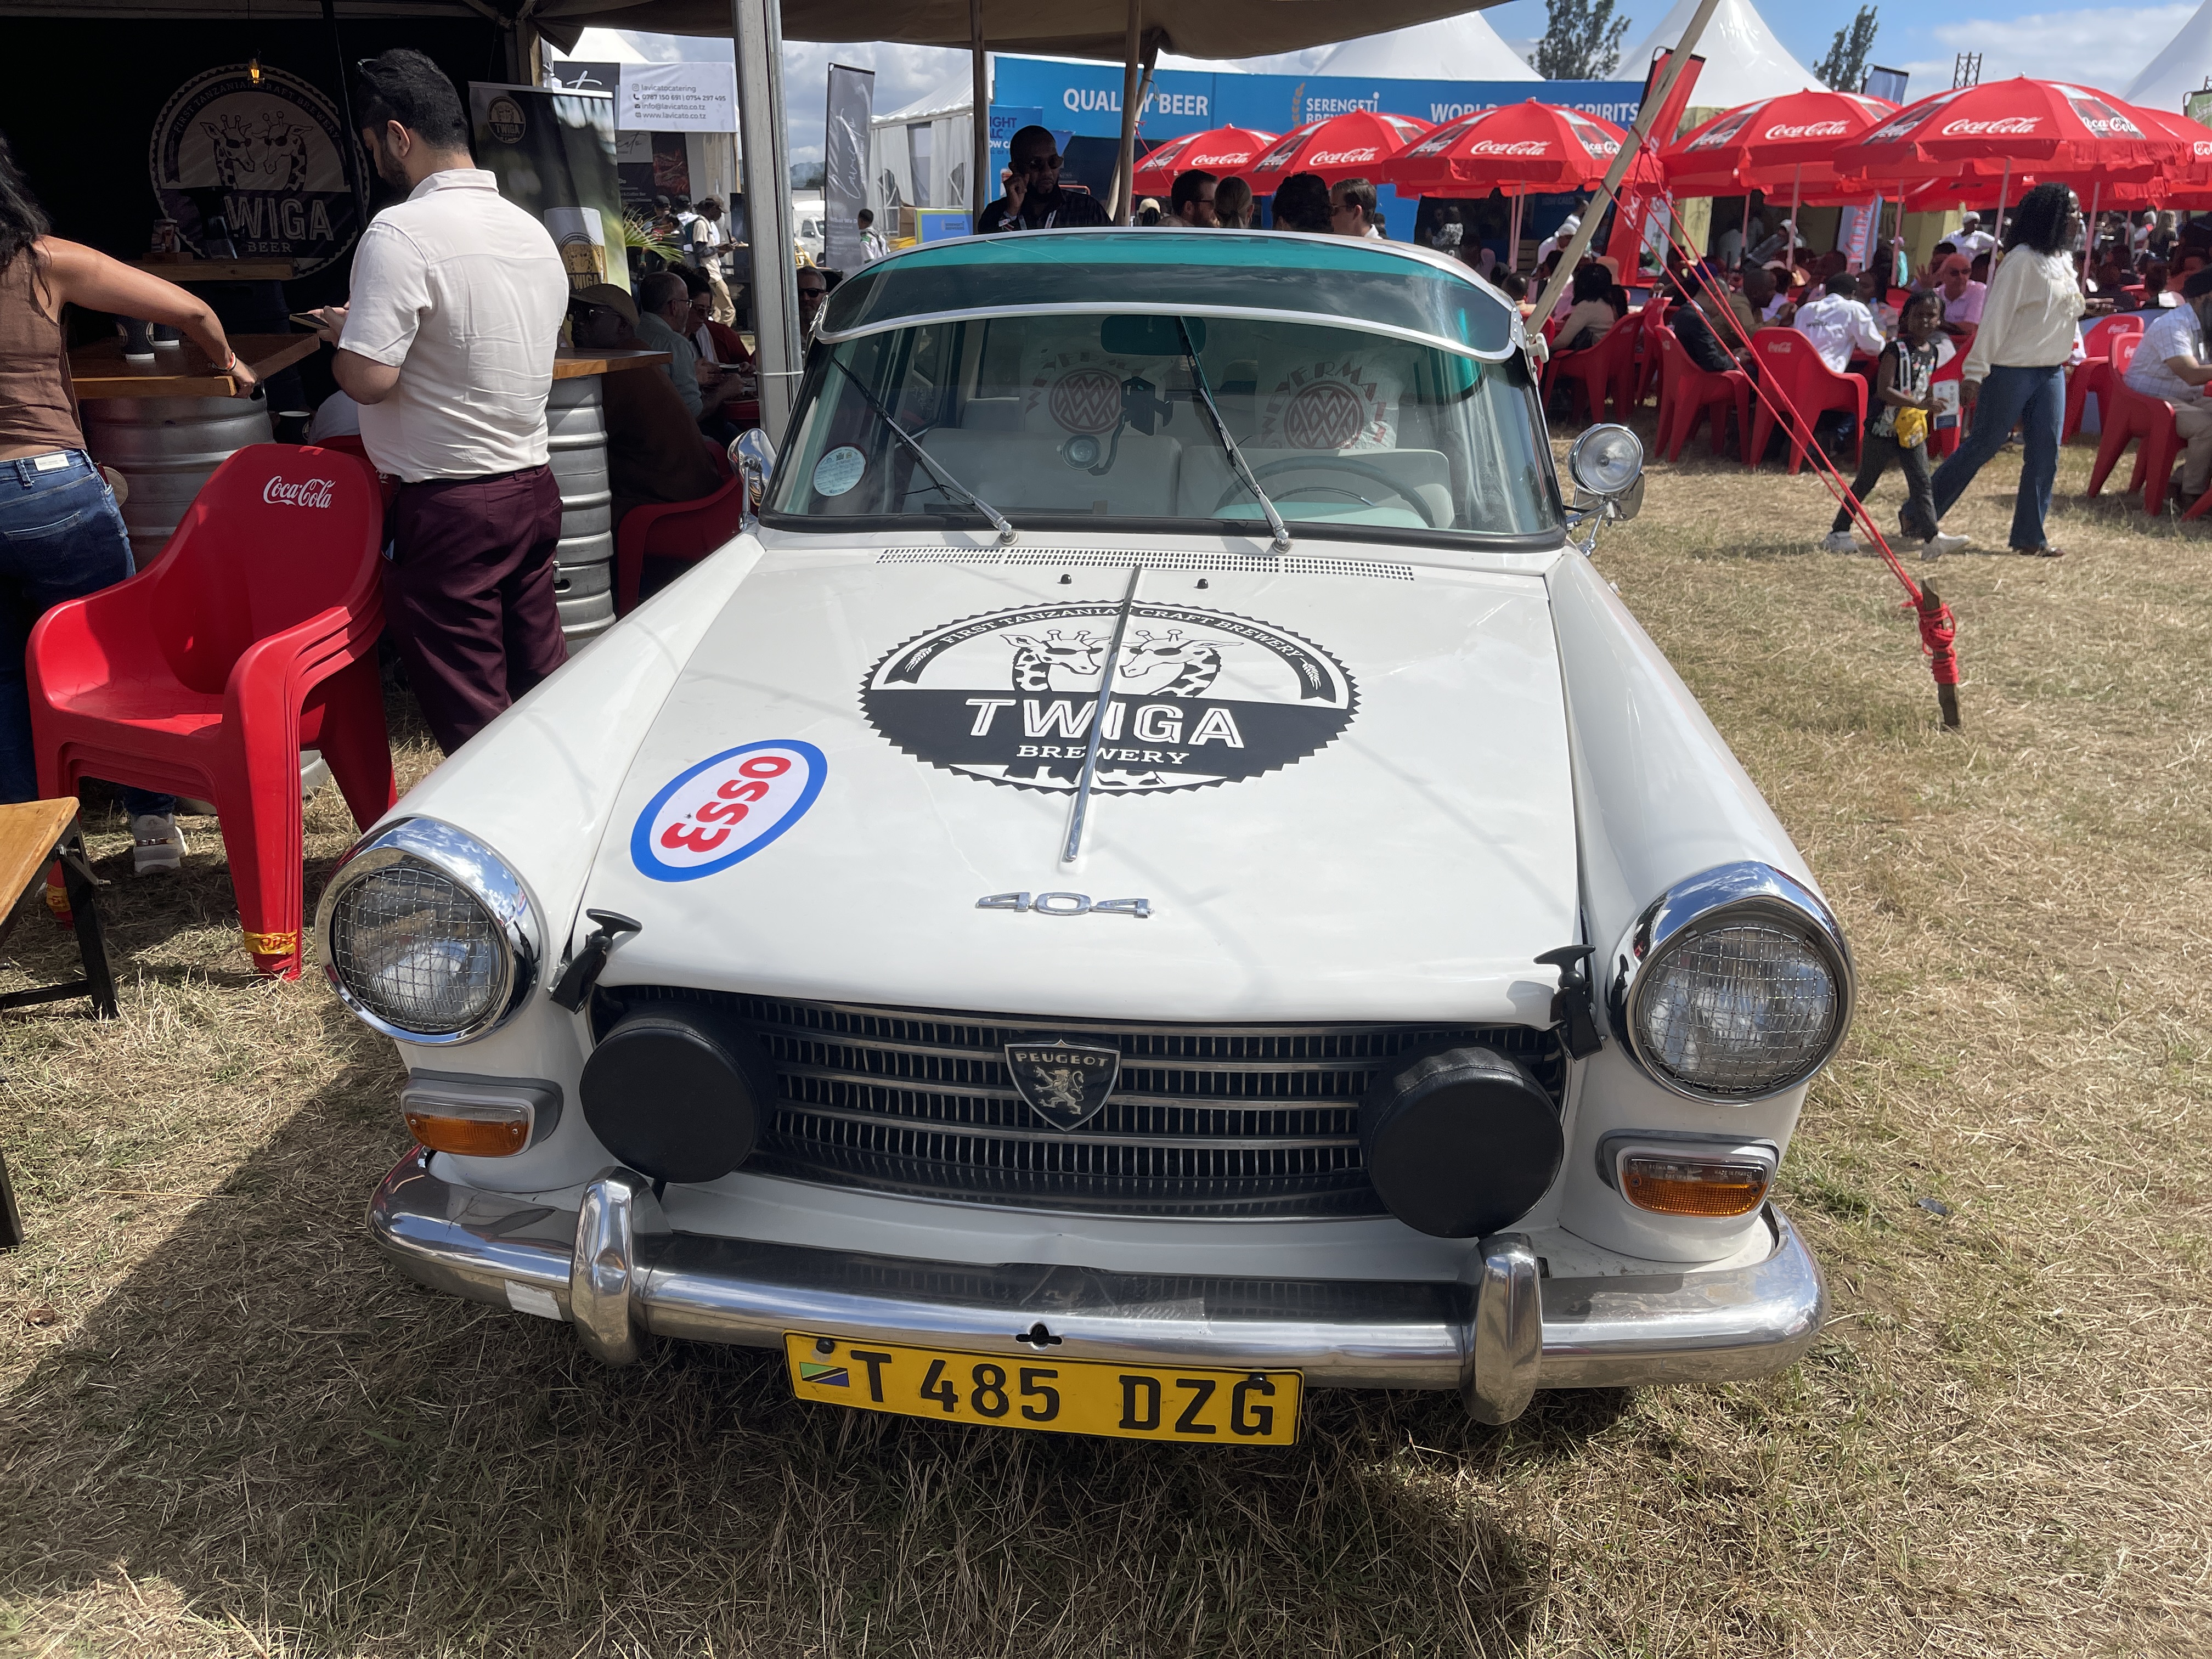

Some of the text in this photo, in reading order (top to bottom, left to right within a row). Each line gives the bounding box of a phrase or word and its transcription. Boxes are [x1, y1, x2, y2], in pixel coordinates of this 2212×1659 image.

[641, 84, 696, 93] lavicatocatering
[1063, 88, 1209, 116] QUALY BEER
[174, 105, 195, 132] FIRST
[297, 96, 340, 139] BREWERY
[990, 116, 1017, 128] IGHT
[1942, 117, 2044, 136] Coca-Cola
[1765, 120, 1851, 140] Coca-Cola
[1309, 147, 1379, 166] Coca-Cola
[1470, 140, 1552, 156] Coca-Cola
[1192, 153, 1252, 166] Coca-Cola
[223, 196, 334, 241] WIGA
[248, 242, 292, 253] BEER
[263, 475, 336, 509] Coca-Cola
[939, 622, 999, 644] FIRST
[1139, 610, 1214, 624] CRAFT
[1214, 620, 1305, 658] BREWERY
[964, 698, 1245, 749] TWIGA
[1015, 744, 1190, 765] BREWERY
[975, 891, 1154, 919] 404
[1014, 1051, 1109, 1068] PEUGEOT
[851, 1350, 1276, 1436] T 485 DZG
